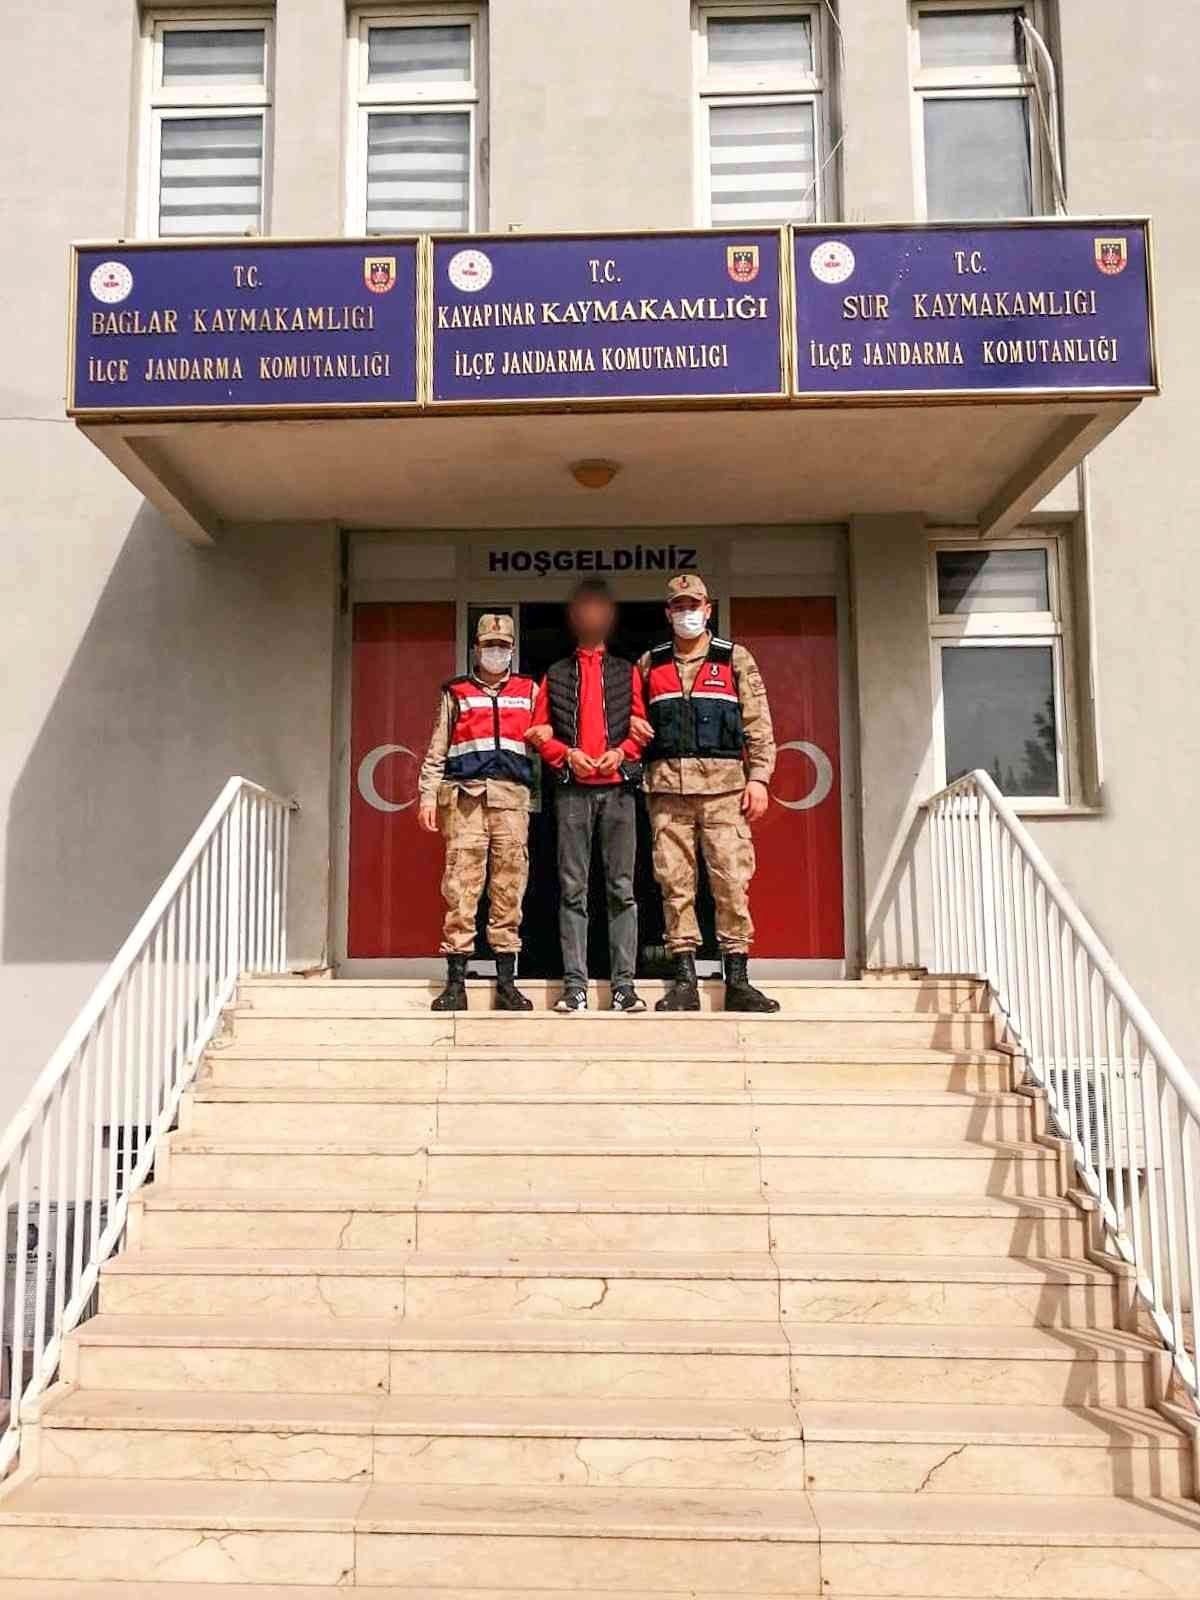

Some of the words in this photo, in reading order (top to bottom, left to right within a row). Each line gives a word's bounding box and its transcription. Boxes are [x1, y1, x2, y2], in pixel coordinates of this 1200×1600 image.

[233, 265, 262, 288] T.C.
[589, 259, 621, 283] T.C.
[954, 251, 987, 274] T.C.
[437, 302, 536, 329] KAYAPINAR
[541, 294, 768, 324] KAYMAKAMLIĞI
[842, 294, 889, 319] SUR
[88, 355, 129, 384] İLÇE
[144, 356, 243, 381] JANDARMA
[259, 351, 391, 379] KOMUTANLIĞI
[454, 350, 495, 379] İLÇE
[502, 348, 596, 375] JANDARMA
[810, 339, 853, 370] İLÇE
[863, 341, 964, 367] JANDARMA
[982, 335, 1119, 364] KOMUTANLIĞI
[488, 545, 697, 576] HOŞGELDİNİZ
